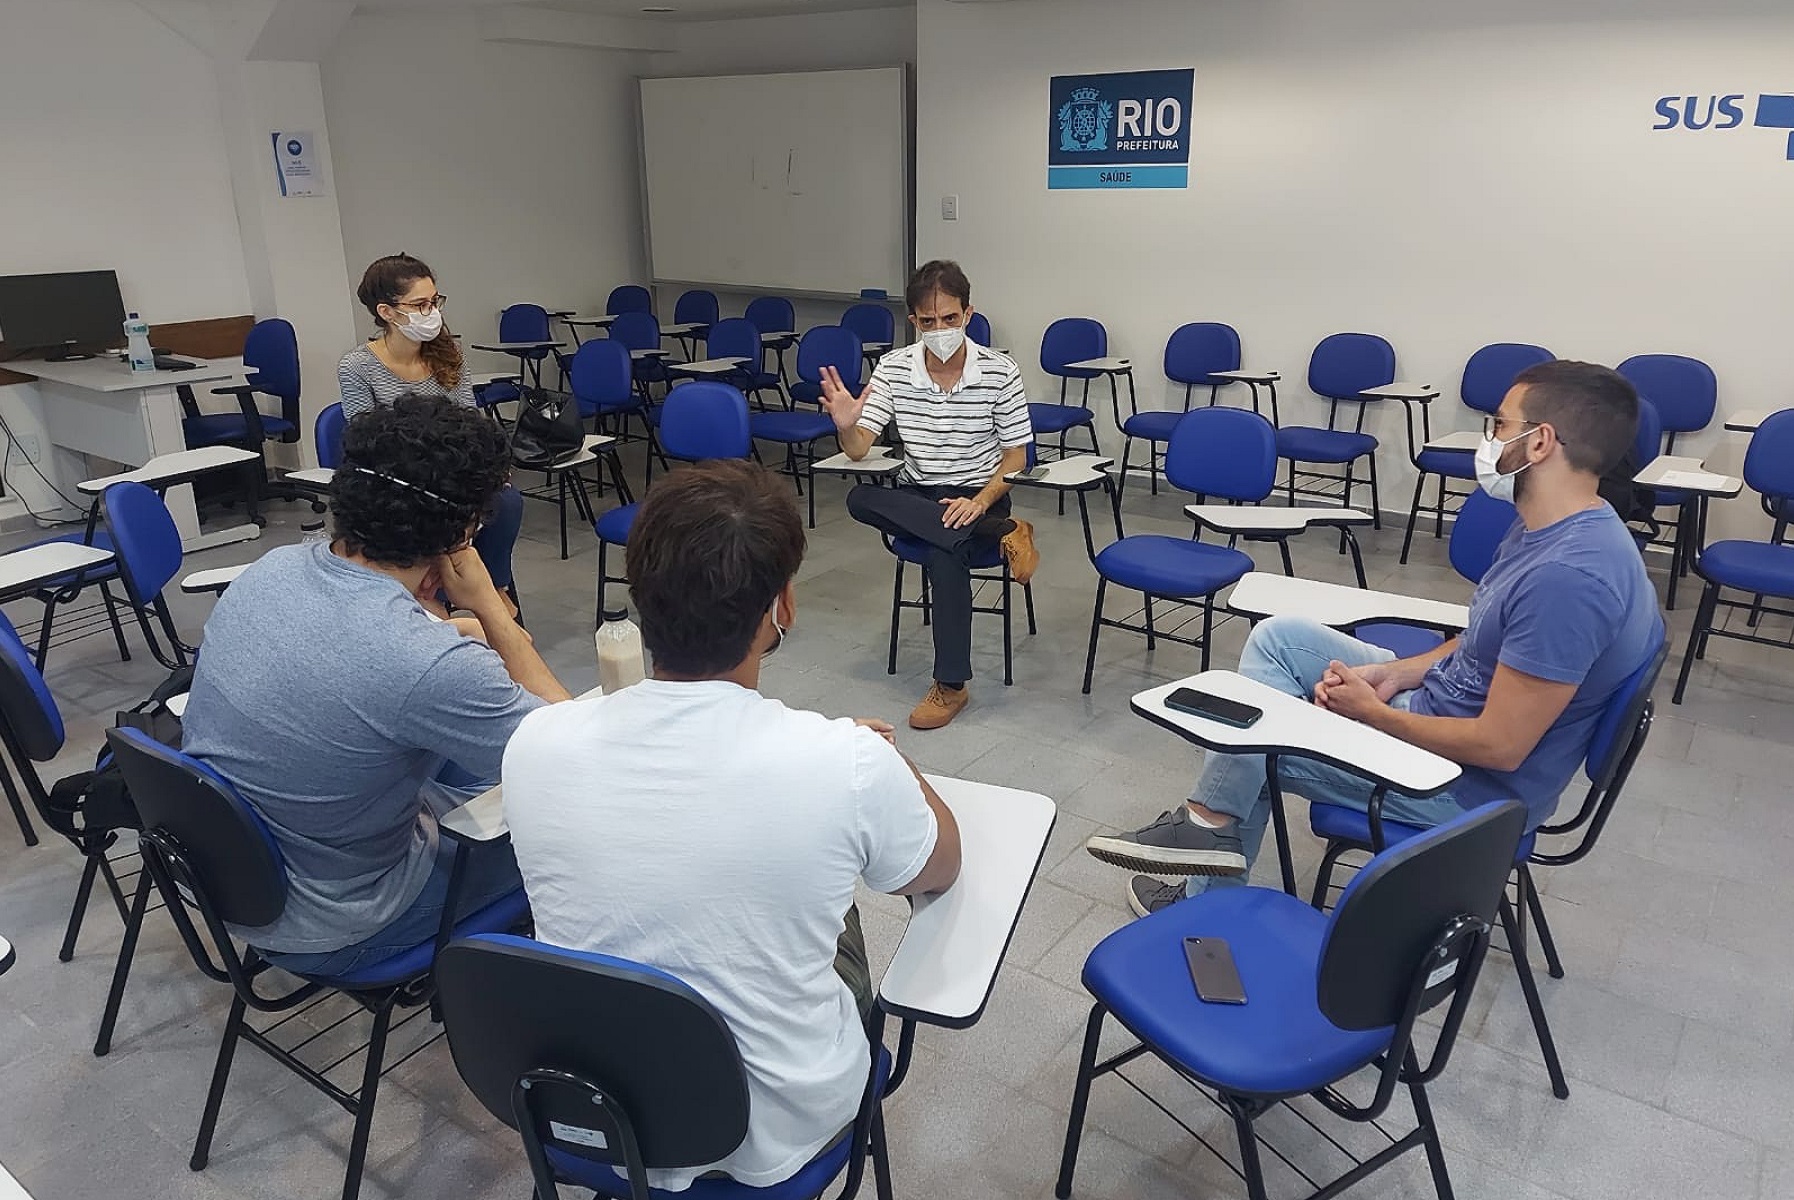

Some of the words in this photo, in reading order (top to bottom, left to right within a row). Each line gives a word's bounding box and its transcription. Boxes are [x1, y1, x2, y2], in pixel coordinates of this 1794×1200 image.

[1116, 97, 1181, 137] RIO
[1653, 94, 1744, 130] SUS
[1116, 140, 1179, 151] PREFEITURA
[1100, 170, 1131, 182] SAÚDE
